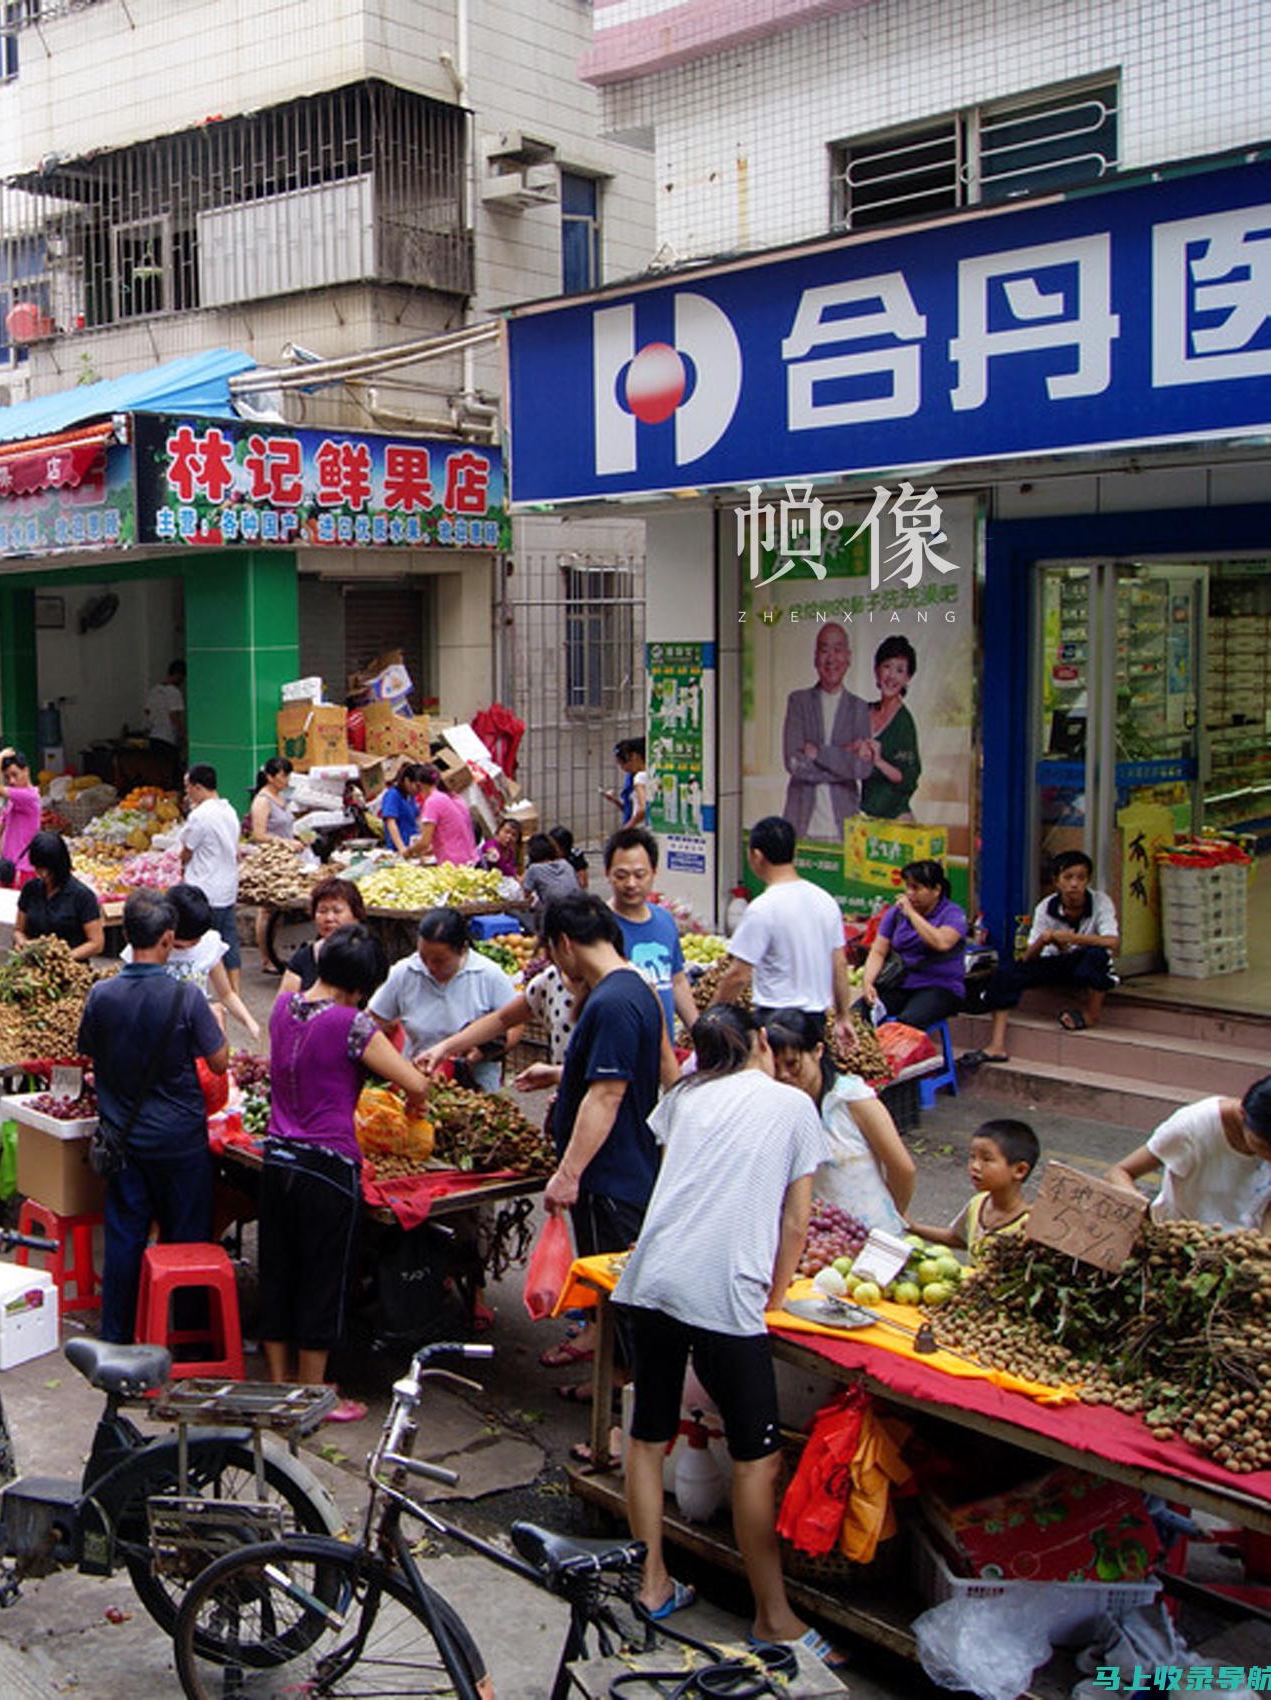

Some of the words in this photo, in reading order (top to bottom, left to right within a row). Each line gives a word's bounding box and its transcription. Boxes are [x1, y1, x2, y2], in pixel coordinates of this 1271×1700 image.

[165, 425, 491, 516] 林记鲜果店
